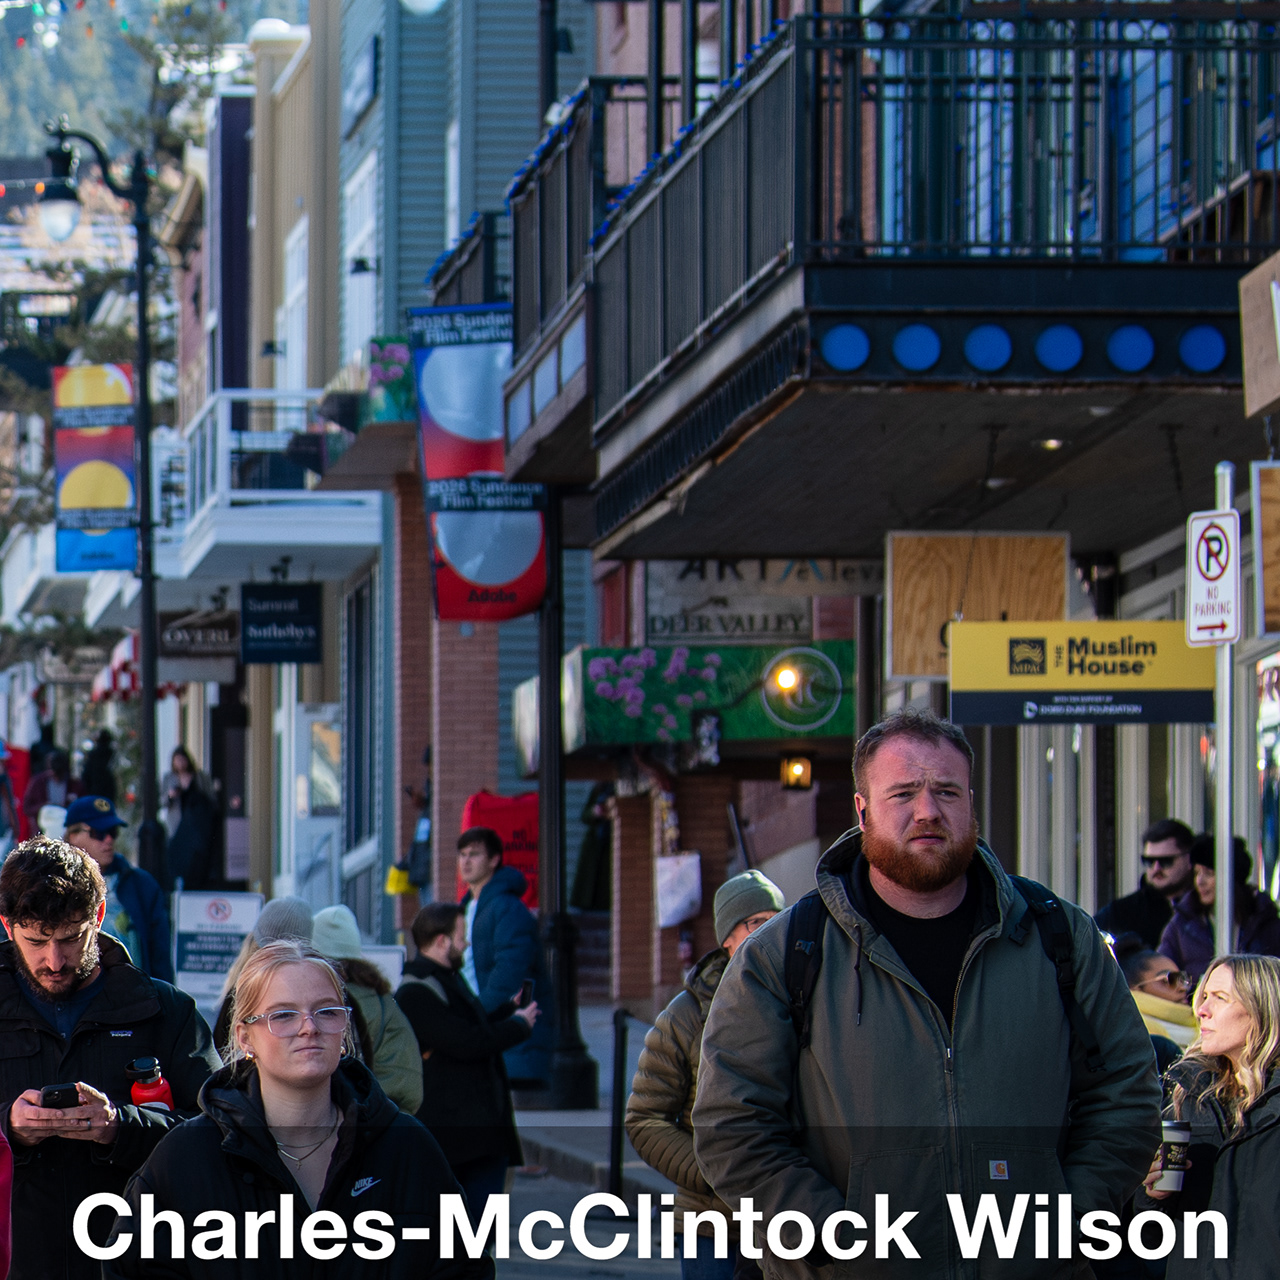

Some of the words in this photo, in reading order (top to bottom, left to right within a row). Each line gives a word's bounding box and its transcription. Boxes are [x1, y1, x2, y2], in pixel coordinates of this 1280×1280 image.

[453, 312, 512, 328] Sundan
[424, 330, 460, 344] Film
[427, 479, 468, 497] 2026
[470, 480, 543, 494] Sundance
[442, 493, 475, 508] Film
[477, 492, 534, 508] Festival
[468, 588, 517, 602] Adobe
[1207, 586, 1218, 600] NO
[1195, 601, 1232, 617] PARKING
[650, 613, 711, 632] DEER
[717, 613, 804, 633] VALLEY
[1068, 635, 1157, 656] Muslim
[1055, 645, 1063, 667] THE
[1068, 658, 1145, 675] House
[354, 1176, 374, 1190] NIKE
